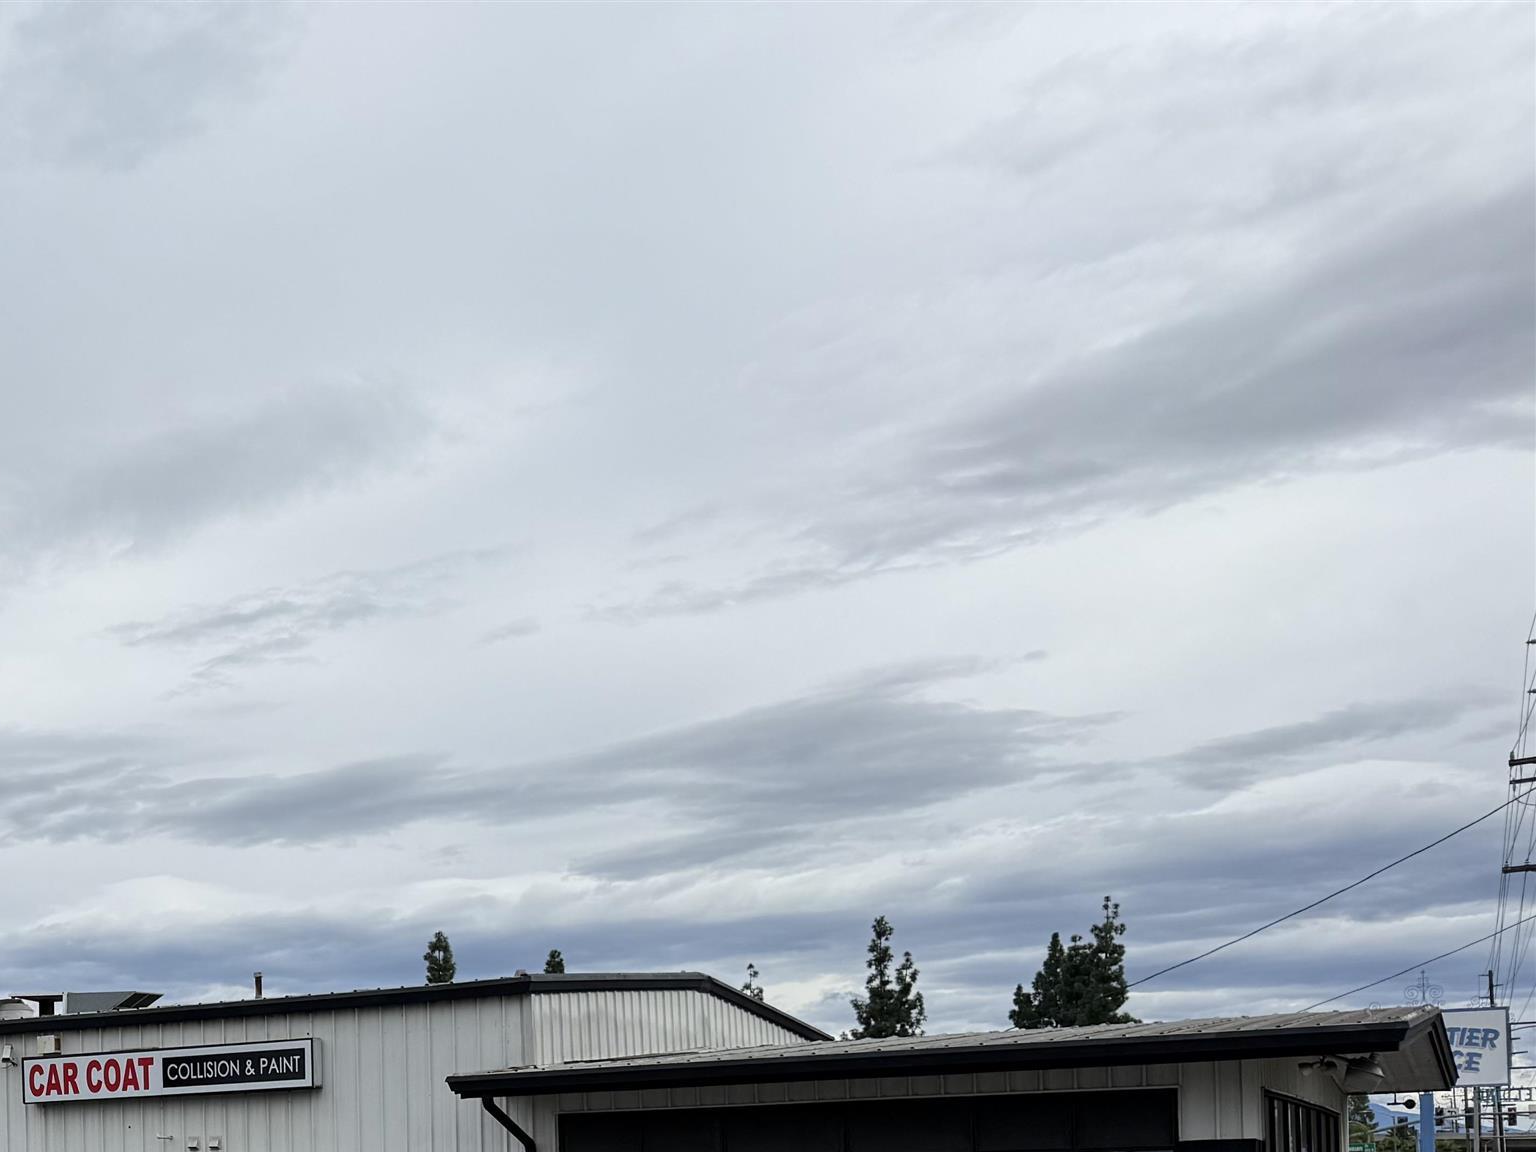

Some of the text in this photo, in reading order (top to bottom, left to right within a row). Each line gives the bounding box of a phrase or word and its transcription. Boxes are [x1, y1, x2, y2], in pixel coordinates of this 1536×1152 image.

[29, 1055, 301, 1097] CAR COAT COLLISION & PAINT
